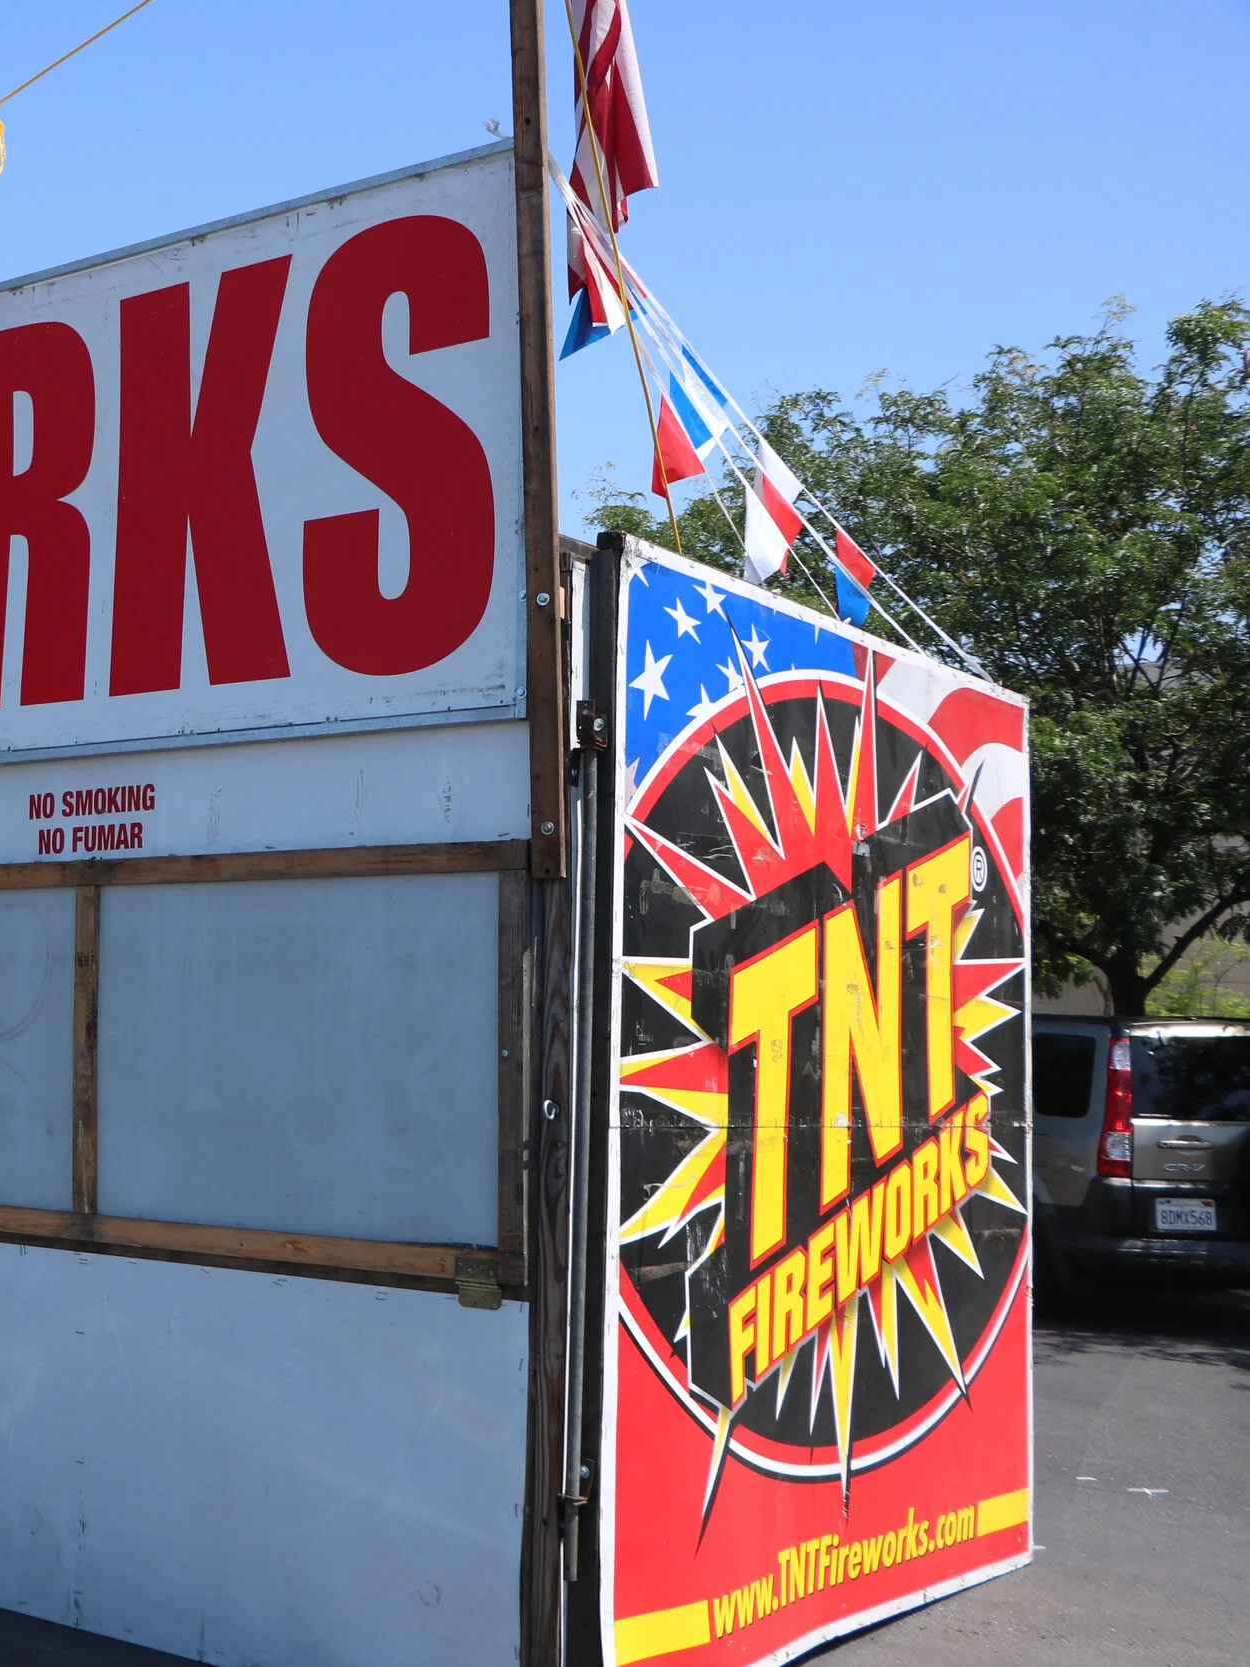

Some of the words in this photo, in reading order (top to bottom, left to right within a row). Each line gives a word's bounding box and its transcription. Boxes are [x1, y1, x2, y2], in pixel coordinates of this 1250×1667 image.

[29, 792, 55, 820] NO
[61, 783, 156, 817] SMOKING
[38, 827, 65, 855] NO
[72, 822, 143, 852] FUMAR
[729, 832, 971, 1270] TNT
[728, 1090, 991, 1408] FIREWORKS
[1161, 1209, 1214, 1226] 8DMX568
[713, 1506, 976, 1639] www.TNTFireworks.com
